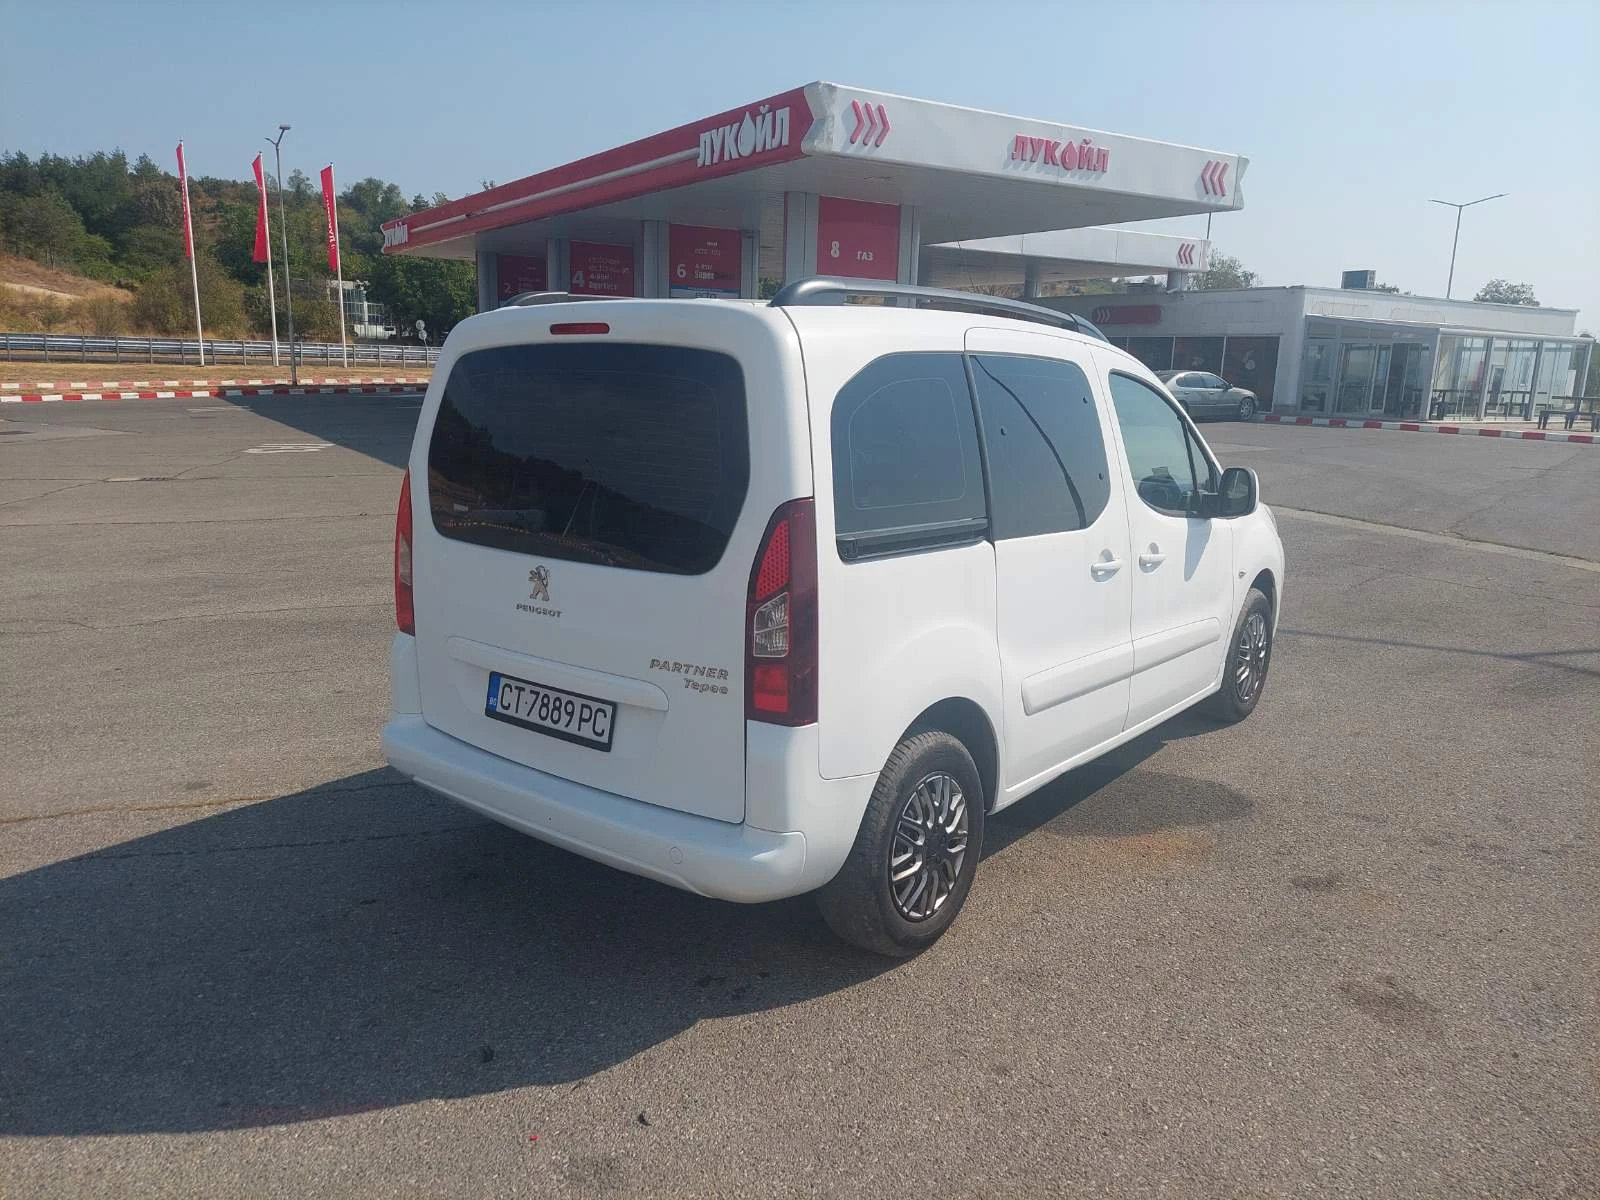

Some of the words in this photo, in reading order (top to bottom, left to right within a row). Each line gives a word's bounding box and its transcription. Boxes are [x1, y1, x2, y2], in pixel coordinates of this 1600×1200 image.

[697, 104, 790, 168] ЛУКОЙЛ
[1011, 134, 1110, 173] ЛУКОЙЛ
[830, 240, 840, 258] 8
[857, 251, 874, 261] ГАЗ
[571, 270, 586, 289] 4
[676, 263, 687, 279] 6
[516, 603, 563, 618] PEUGEOT
[649, 658, 729, 680] PARTNER
[683, 677, 729, 695] Tepee
